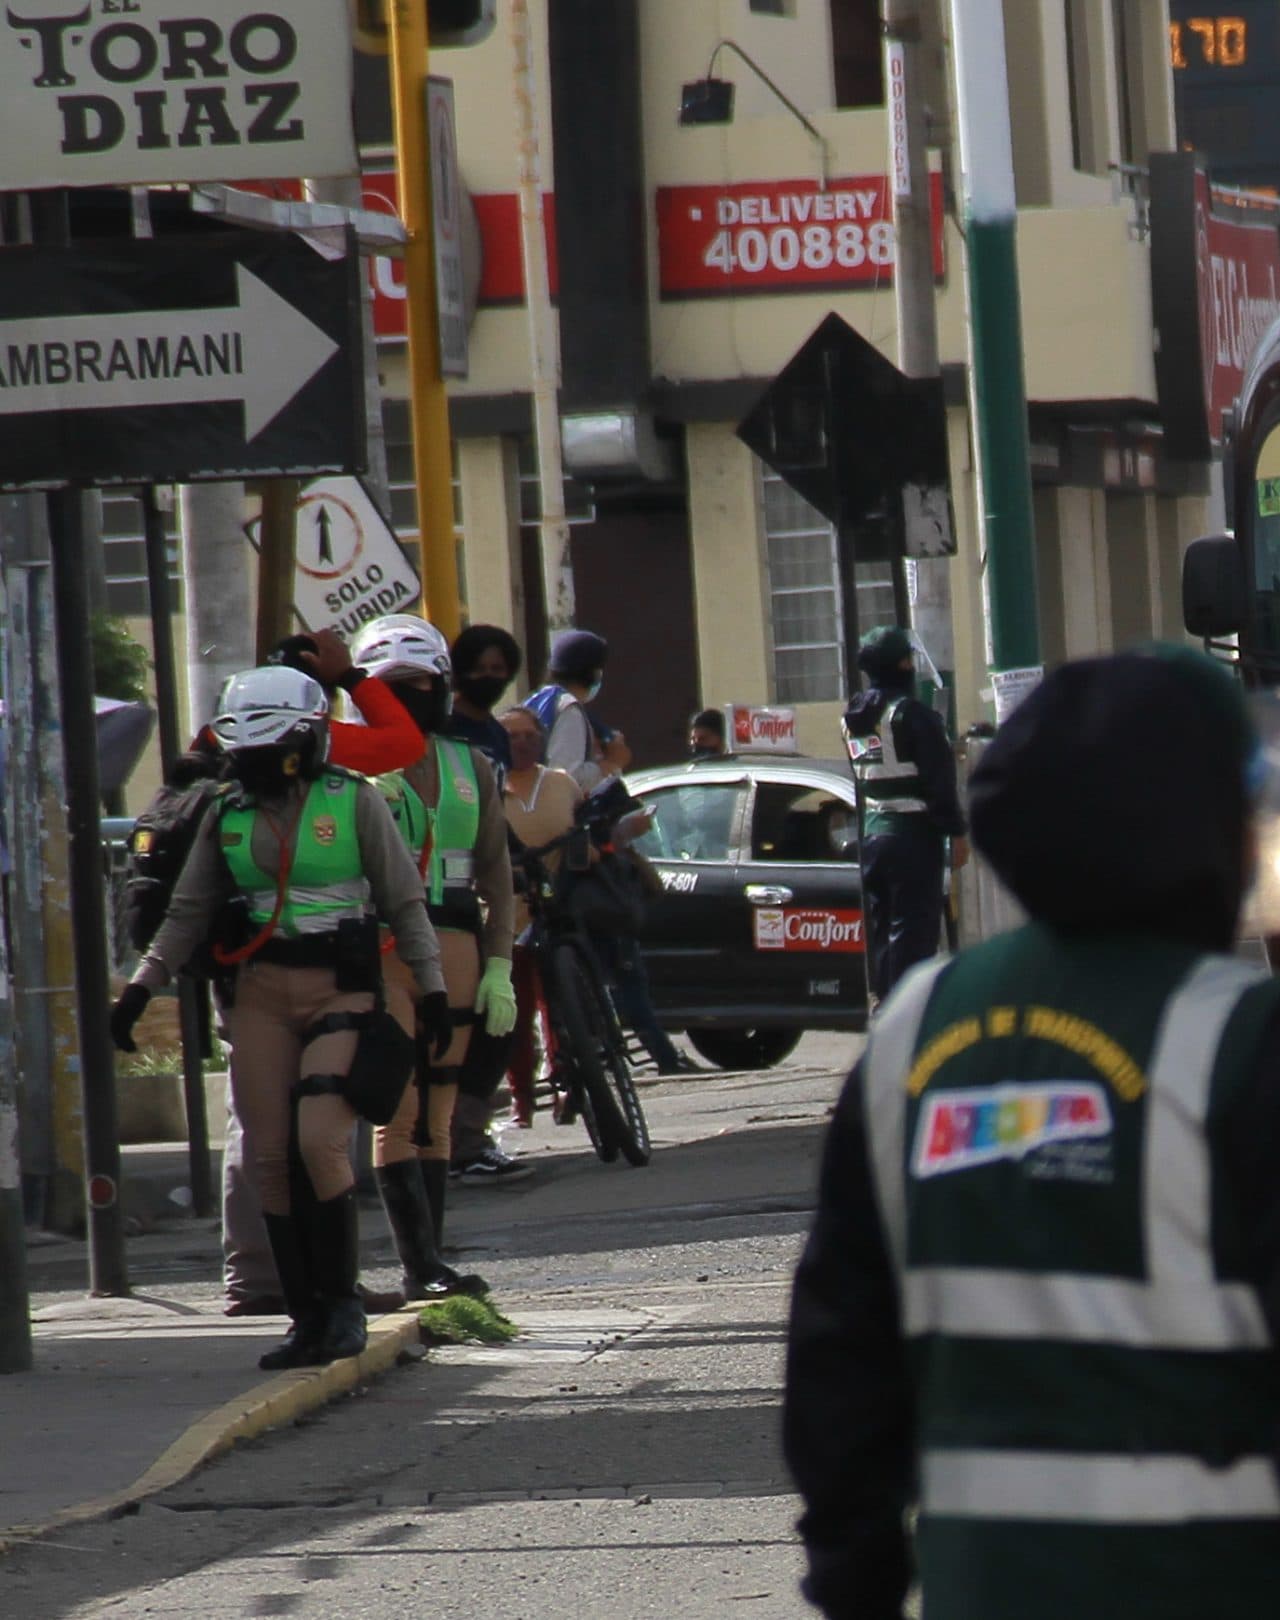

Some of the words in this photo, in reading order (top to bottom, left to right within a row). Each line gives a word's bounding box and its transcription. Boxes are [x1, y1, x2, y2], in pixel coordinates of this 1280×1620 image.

[6, 0, 298, 87] TORO
[57, 82, 304, 155] DIAZ
[718, 191, 878, 225] DELIVERY
[704, 222, 896, 274] 400888
[0, 332, 243, 388] MBRAMANI
[325, 564, 384, 613] SOLO
[329, 580, 411, 641] SUBIDA
[785, 914, 862, 948] Confort
